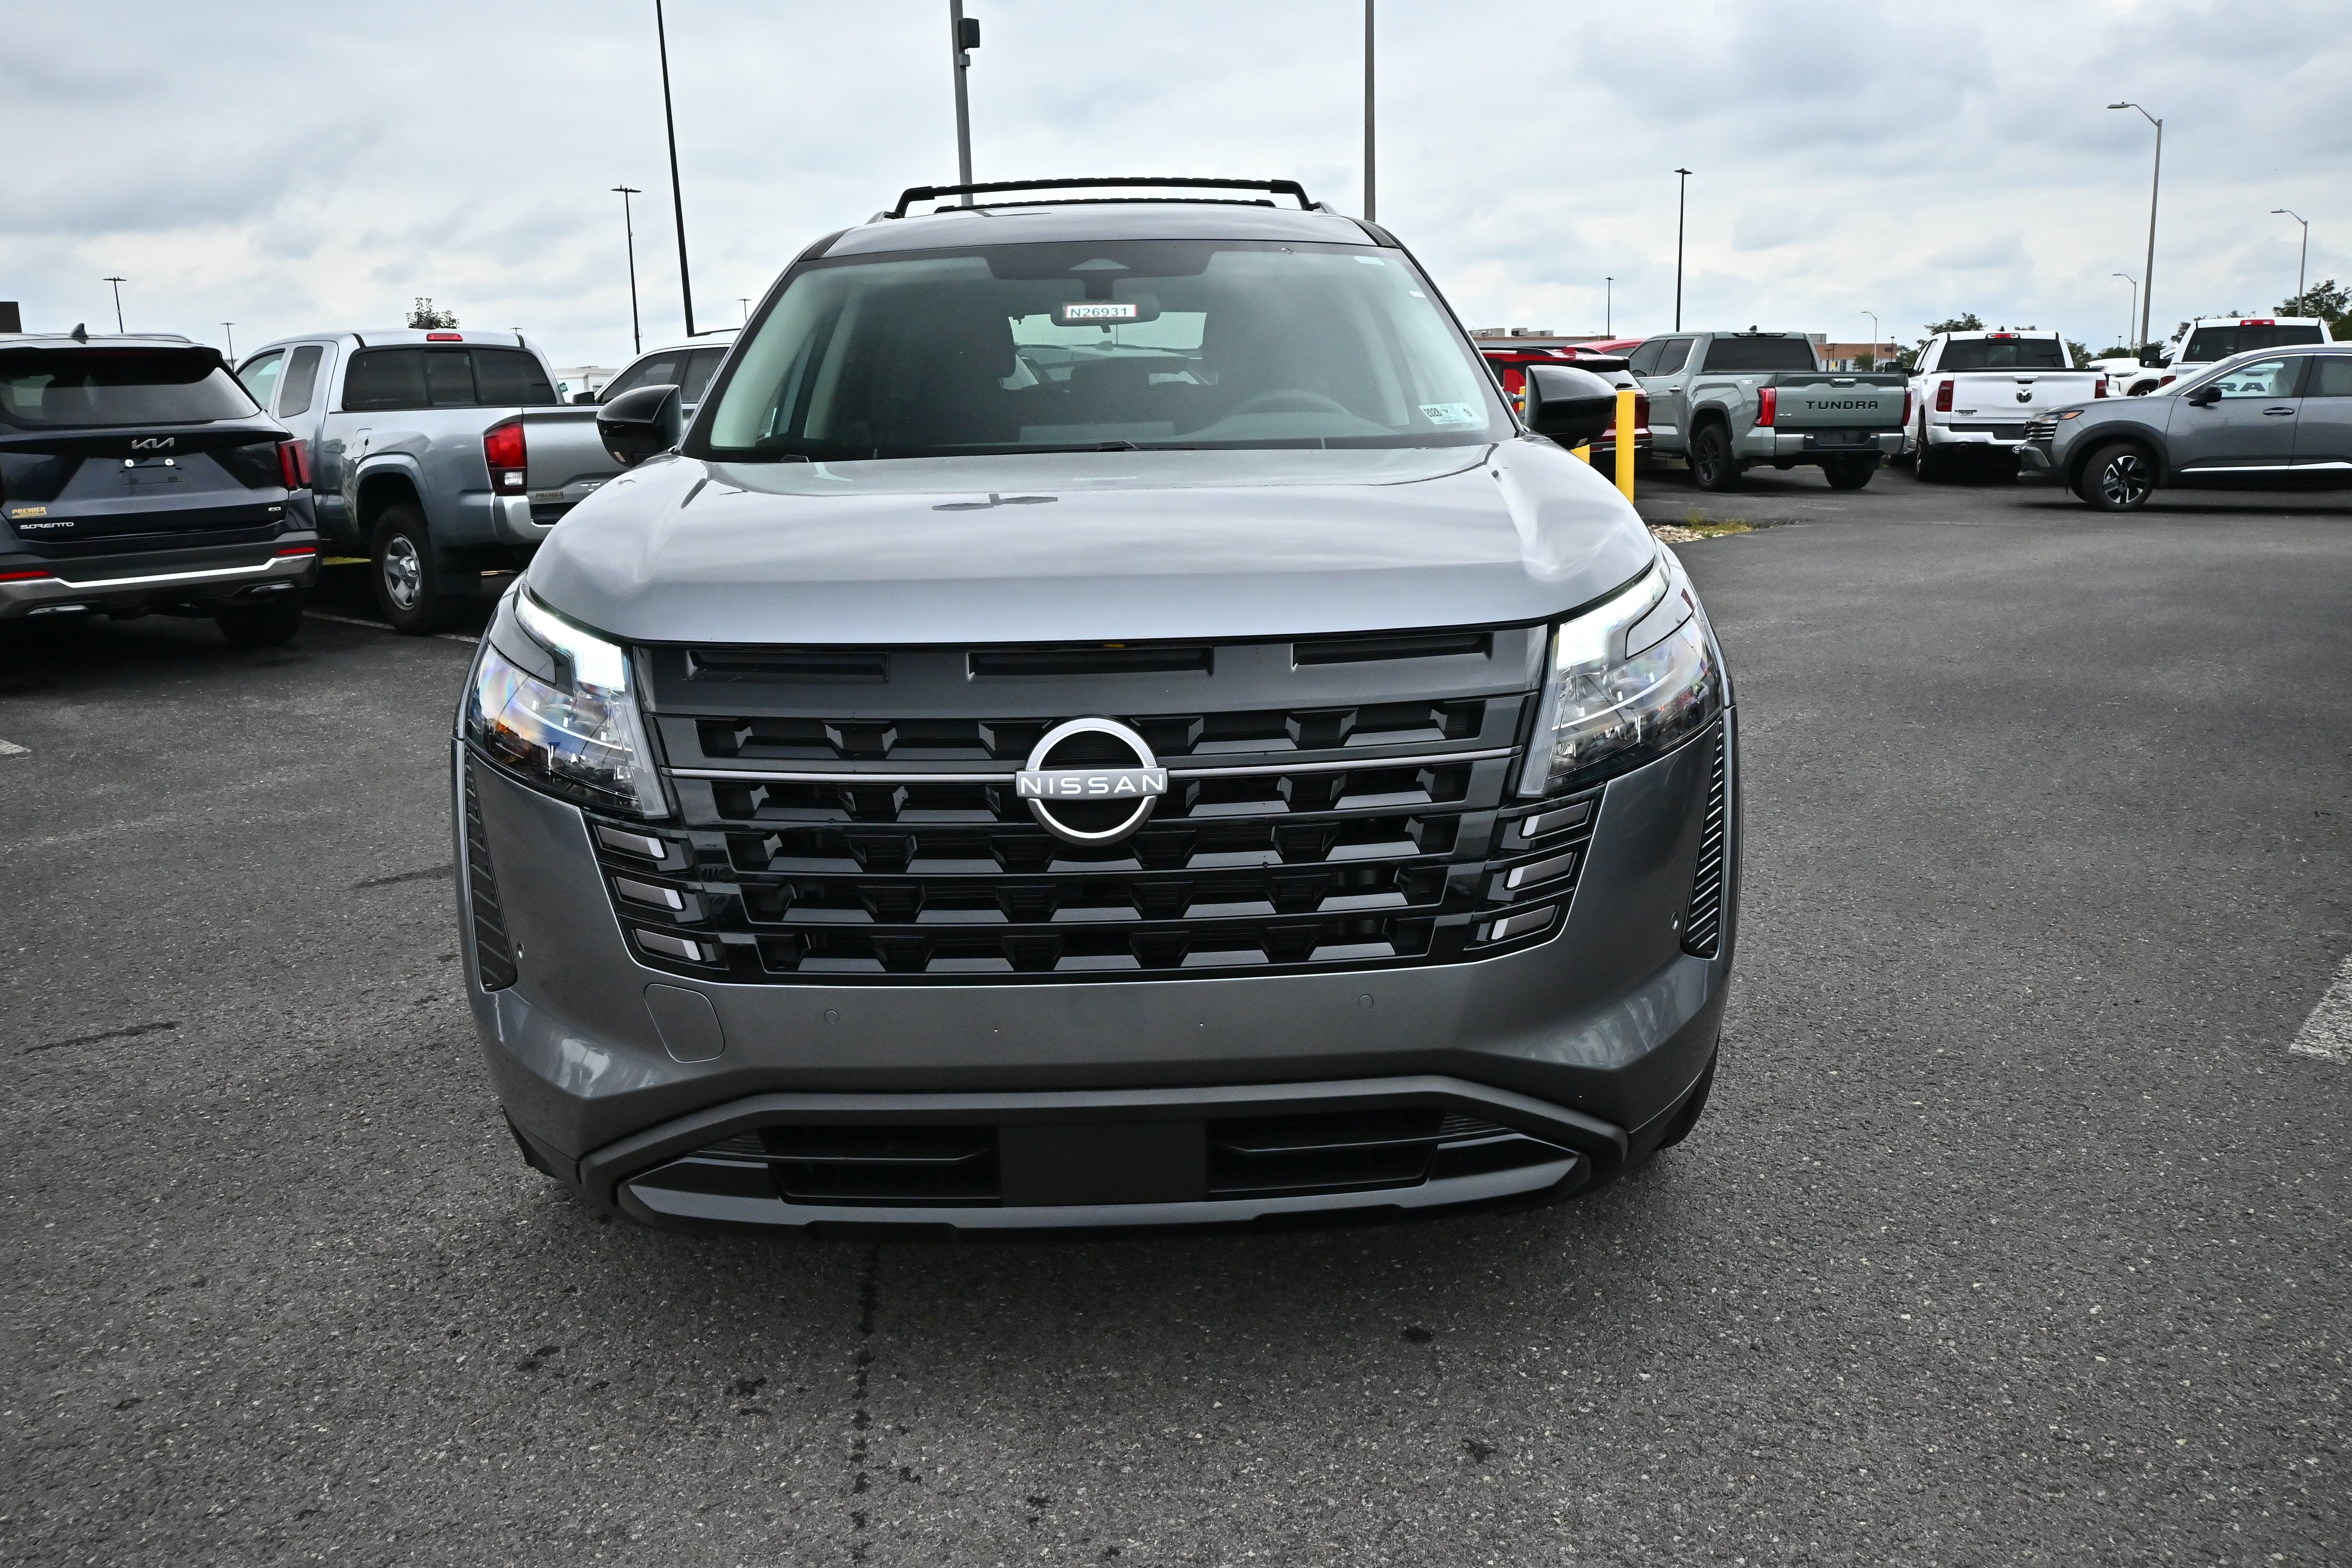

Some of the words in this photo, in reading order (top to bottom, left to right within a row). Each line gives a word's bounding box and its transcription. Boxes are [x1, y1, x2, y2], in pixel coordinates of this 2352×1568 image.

[1070, 308, 1127, 317] N26931
[2212, 382, 2271, 392] RA
[1805, 401, 1878, 410] TUNDRA
[1463, 408, 1473, 417] 9
[131, 437, 174, 449] KIA
[1021, 773, 1163, 794] NISSAN
